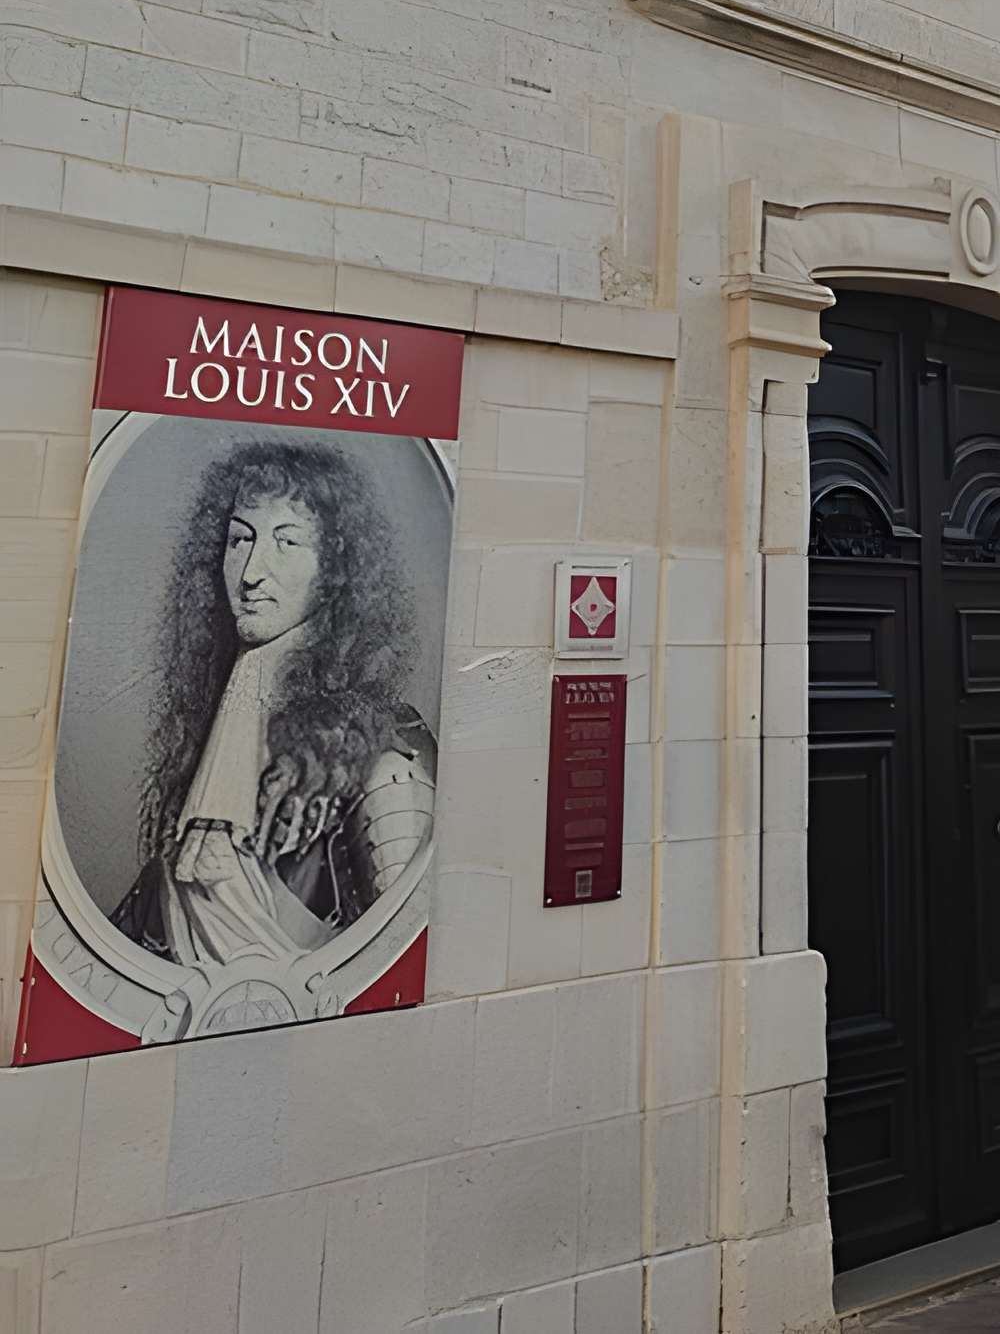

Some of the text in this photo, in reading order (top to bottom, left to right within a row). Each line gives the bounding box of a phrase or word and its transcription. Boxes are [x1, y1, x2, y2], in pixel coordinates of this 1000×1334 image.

[189, 316, 388, 374] MAISON
[164, 358, 410, 418] LOUIS XIV
